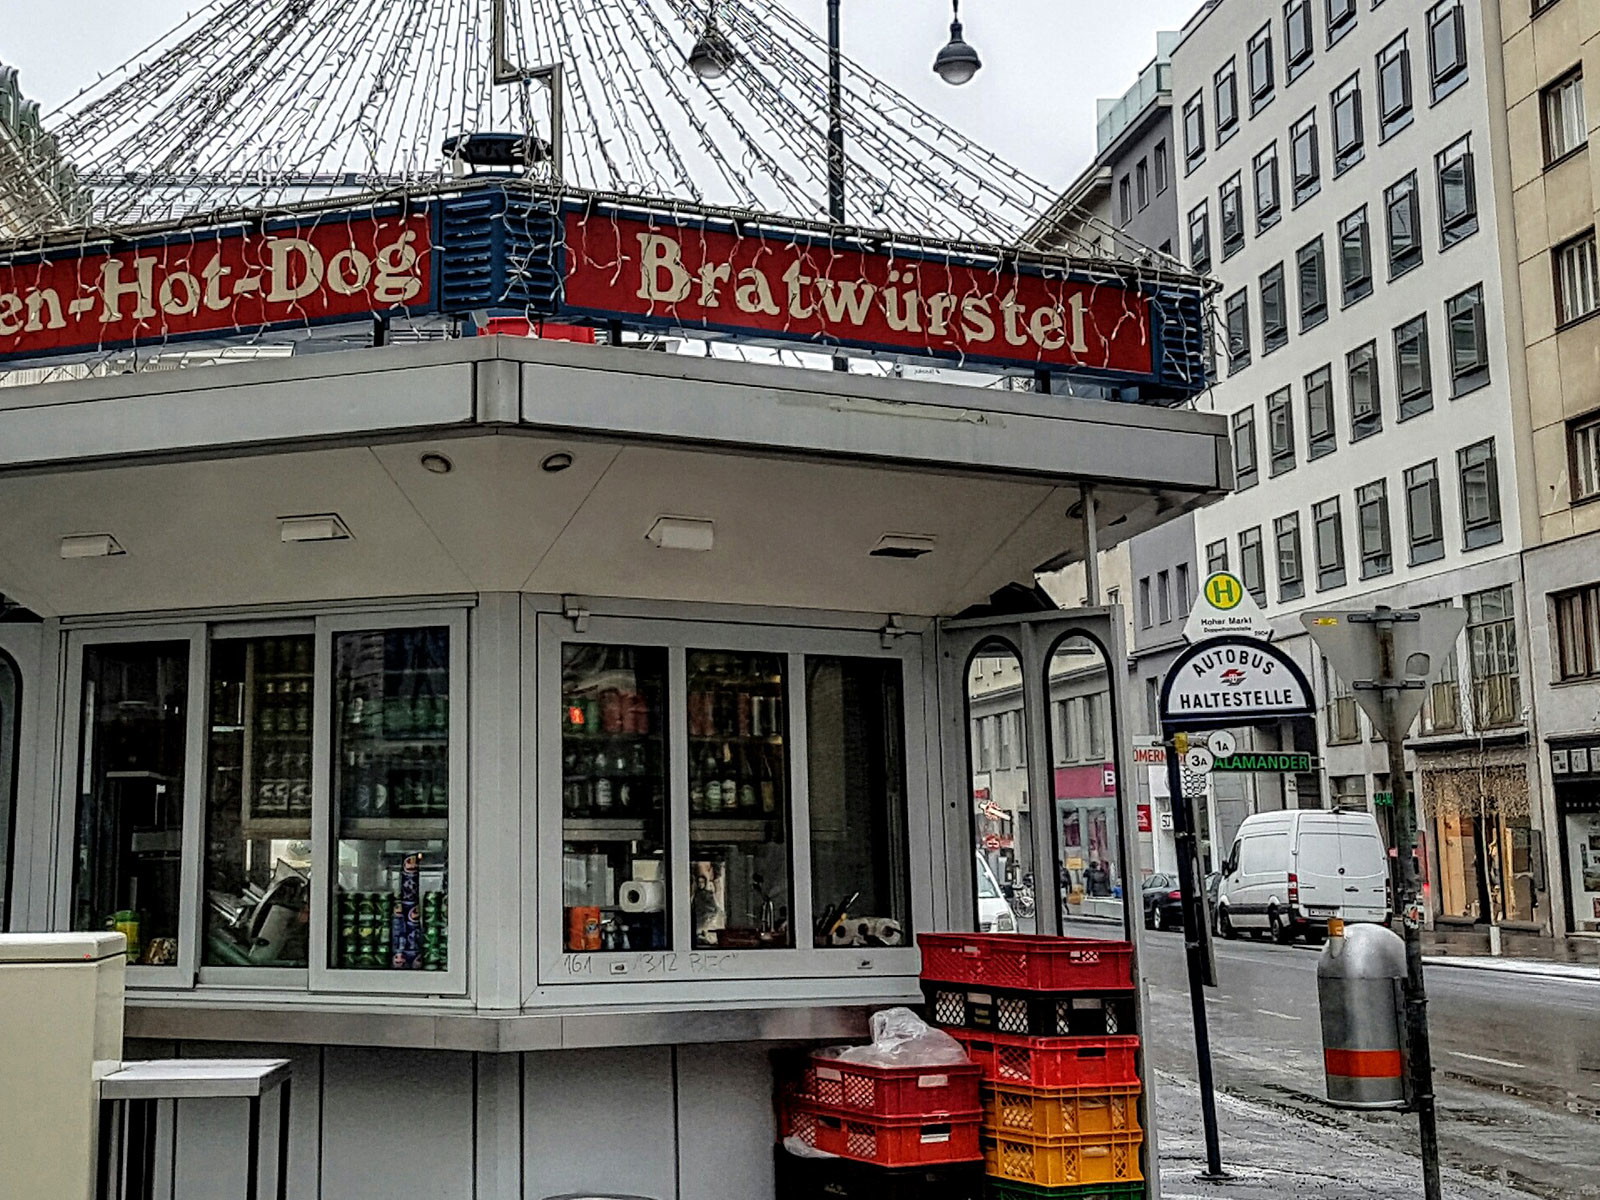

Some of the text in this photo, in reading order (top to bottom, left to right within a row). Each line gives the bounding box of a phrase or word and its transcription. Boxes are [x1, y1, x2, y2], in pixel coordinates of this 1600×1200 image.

[635, 231, 1089, 354] Bratwürstel
[1212, 579, 1234, 604] H
[1201, 617, 1252, 626] Hoher Markt
[1192, 648, 1275, 677] AUTOBUS
[1180, 689, 1293, 709] HALTESTELLE
[1215, 741, 1229, 752] 1A
[1191, 755, 1208, 766] 3A
[1213, 755, 1308, 771] ALAMANDER
[564, 954, 592, 975] 161
